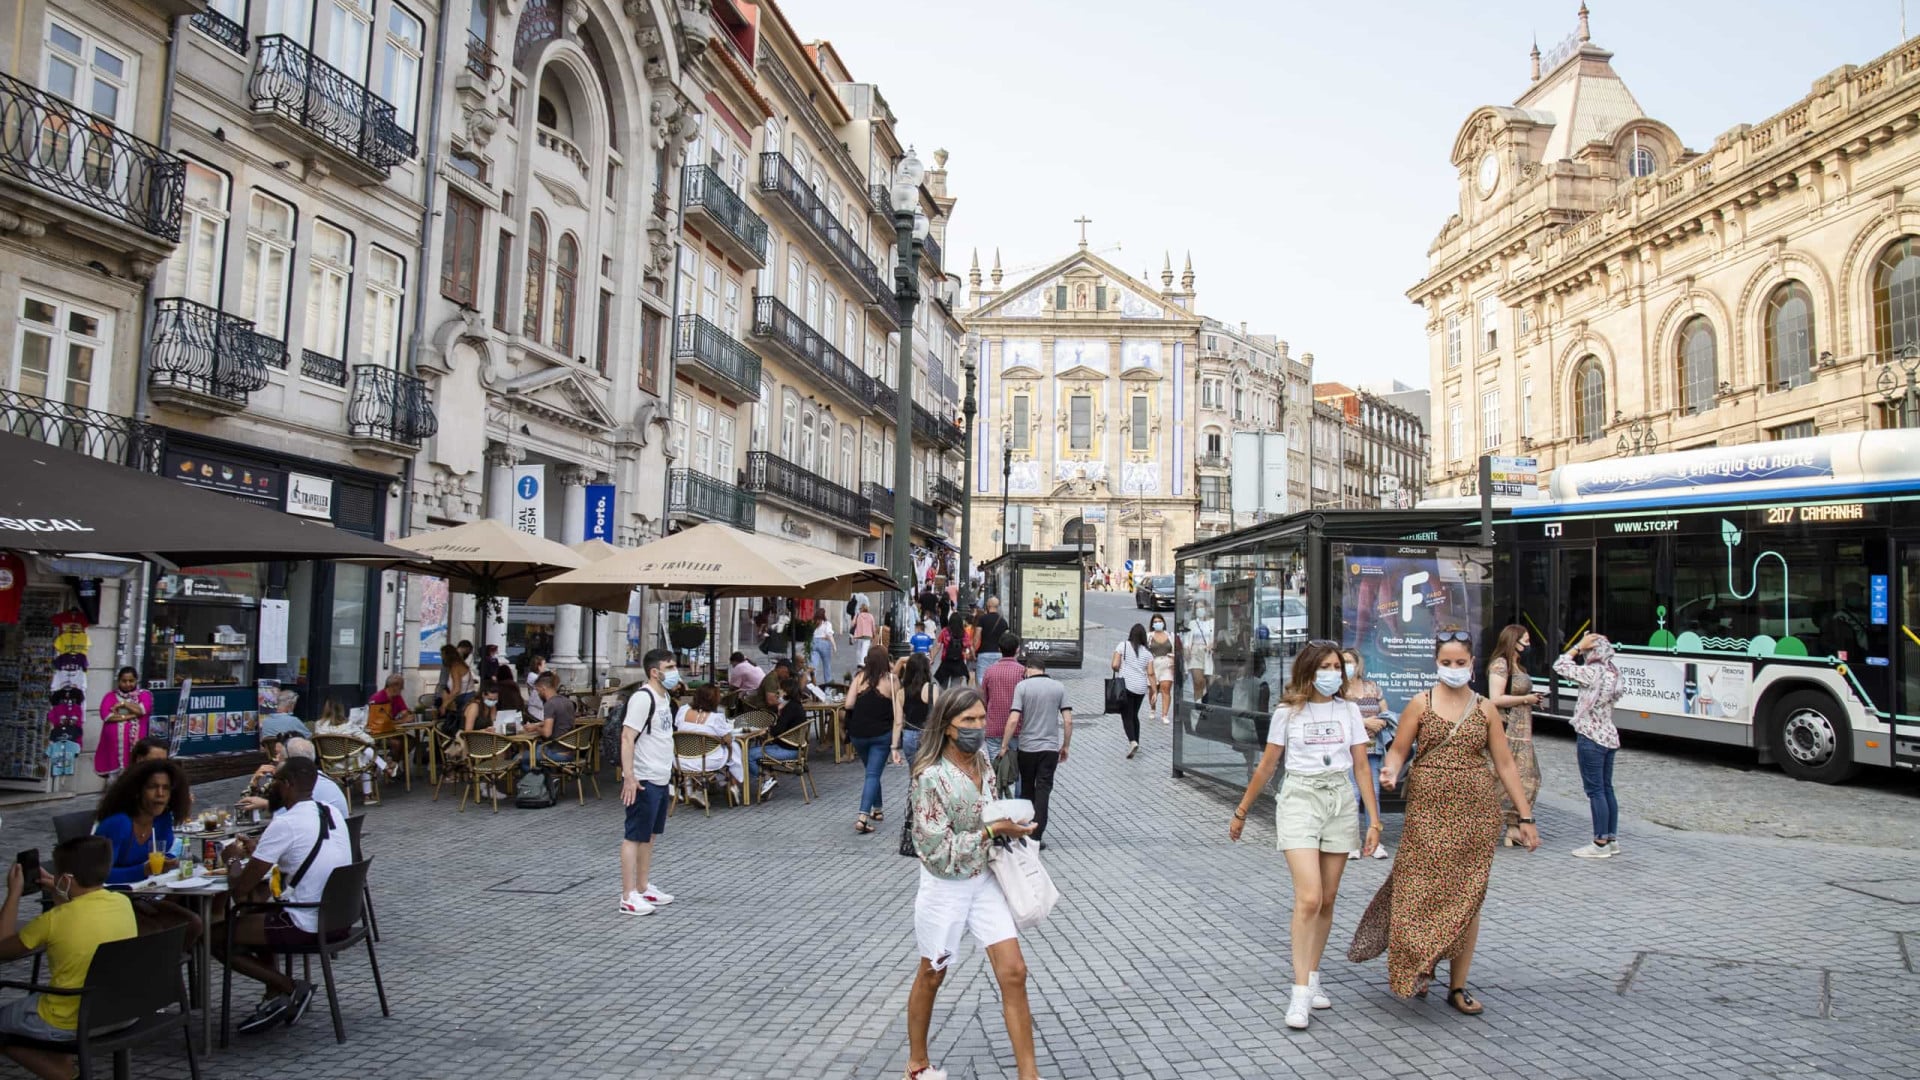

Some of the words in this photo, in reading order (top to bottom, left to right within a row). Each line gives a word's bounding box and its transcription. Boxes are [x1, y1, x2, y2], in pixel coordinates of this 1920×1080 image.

[1691, 457, 1743, 477] energia
[1771, 450, 1814, 469] norte
[1492, 472, 1505, 480] 500
[301, 493, 329, 507] TRAVELLER
[593, 496, 606, 534] Porto.
[1767, 507, 1794, 523] 207
[1800, 504, 1864, 521] CAMPANHÃ
[1614, 520, 1680, 533] WWW.STCP.PT
[661, 561, 722, 572] TRAVELLER
[1402, 571, 1429, 622] F
[1024, 641, 1050, 650] -10%
[1382, 636, 1403, 644] Pedro
[1367, 671, 1389, 680] Aurea,
[1390, 671, 1419, 679] Carolina
[1721, 666, 1744, 675] Rexona
[1628, 677, 1656, 688] STRESS
[190, 695, 226, 709] TRAVELLER
